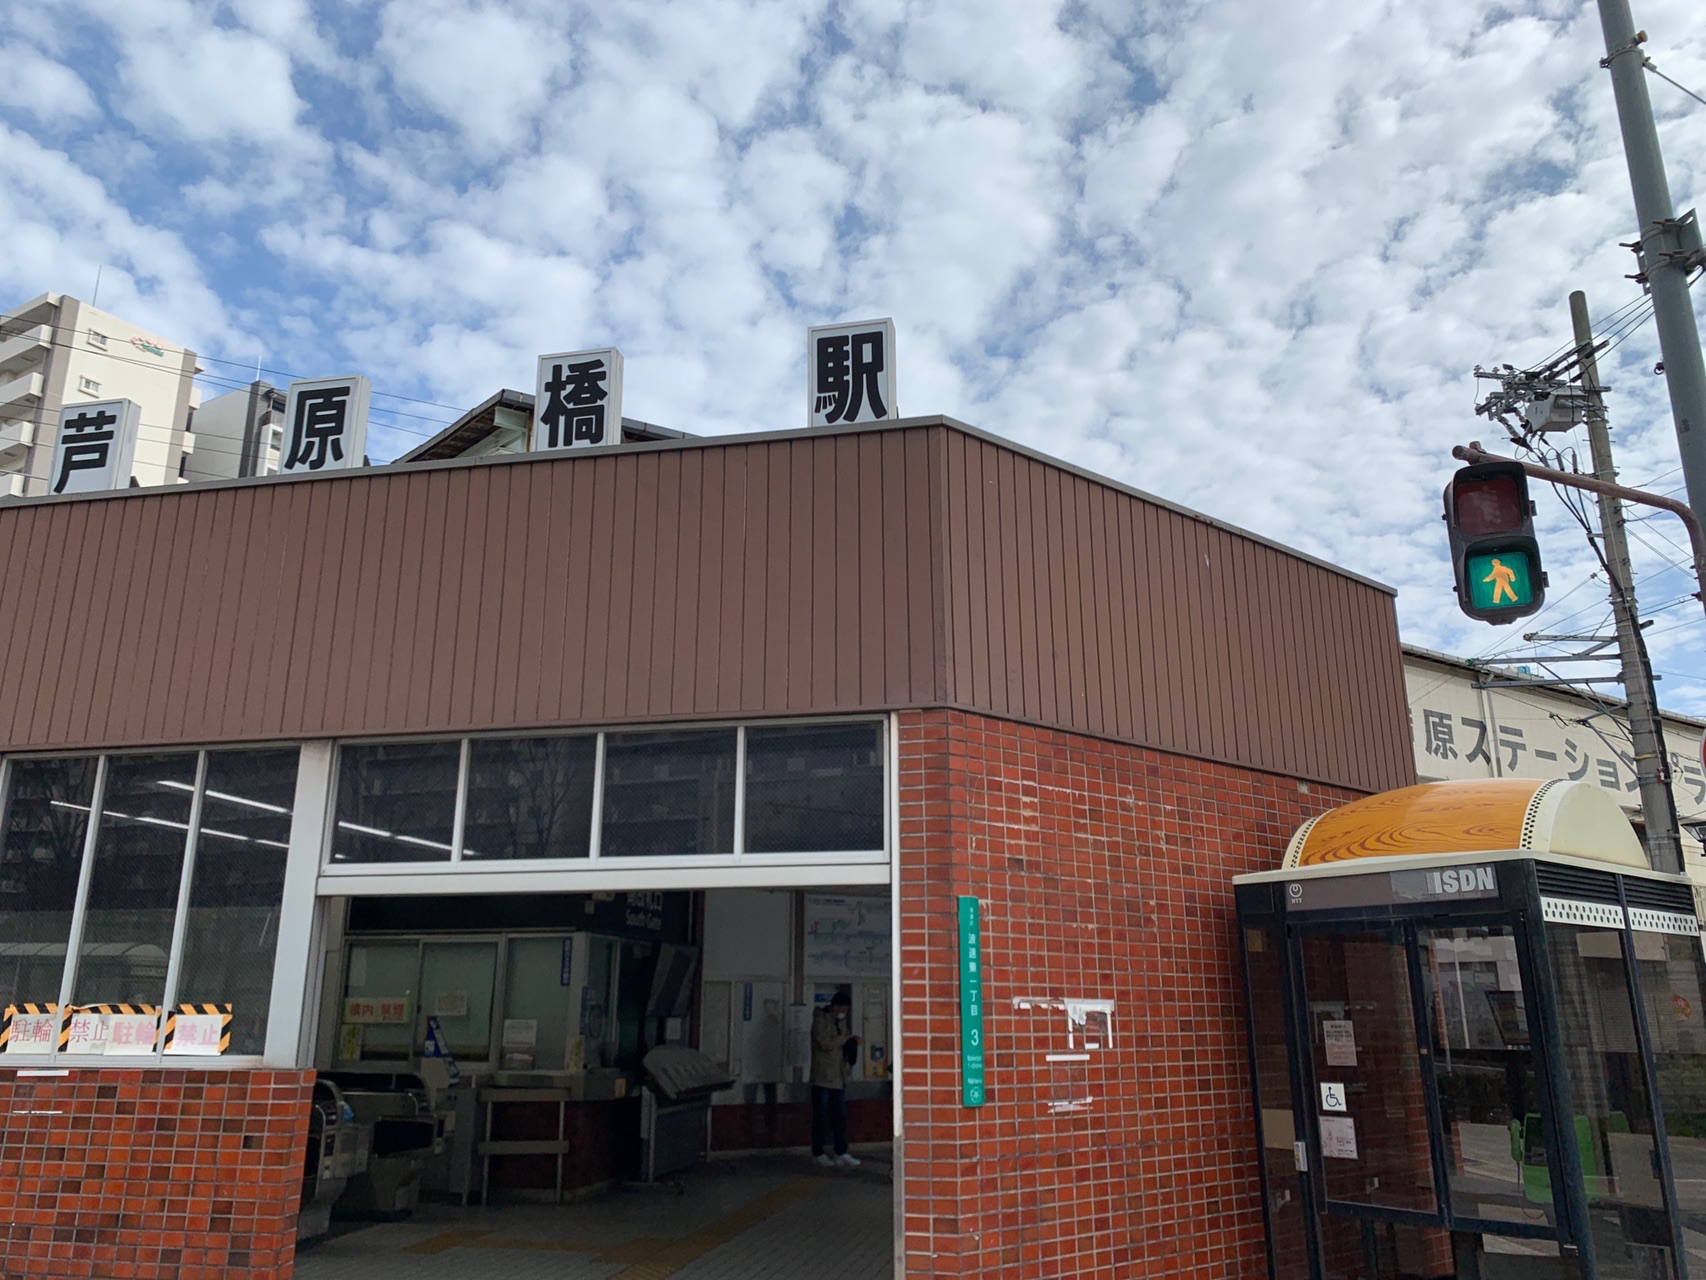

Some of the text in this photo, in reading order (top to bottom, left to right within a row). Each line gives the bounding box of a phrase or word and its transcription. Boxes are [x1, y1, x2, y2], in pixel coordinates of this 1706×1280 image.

[53, 330, 888, 494] 芦 原 橋 駅
[1429, 866, 1495, 895] ISDN
[10, 1019, 109, 1043] 駐輪 禁止
[111, 1020, 219, 1047] 駐輪 禁止
[970, 1028, 980, 1047] 3
